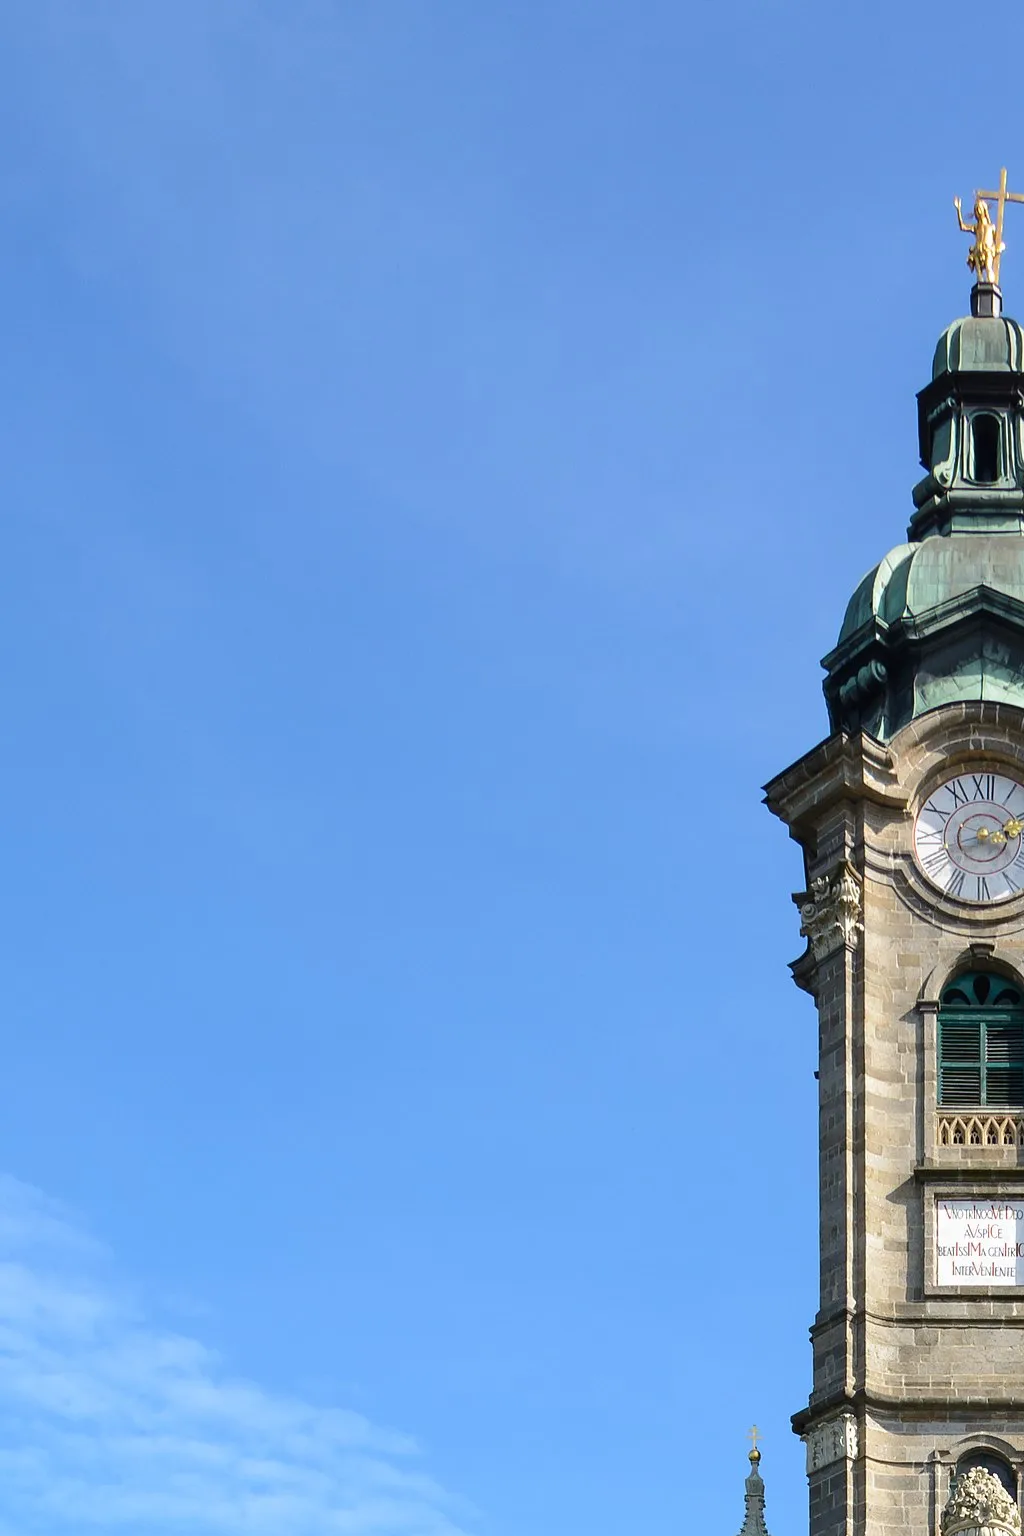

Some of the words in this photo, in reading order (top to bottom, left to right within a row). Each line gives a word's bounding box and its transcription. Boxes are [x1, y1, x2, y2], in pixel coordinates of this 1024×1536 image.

[945, 778, 969, 809] XI
[972, 775, 996, 800] XII
[923, 800, 951, 823] X
[917, 829, 943, 845] IX
[921, 849, 949, 878] VIII
[944, 868, 965, 897] VII
[977, 876, 991, 901] VI
[1002, 871, 1020, 893] V
